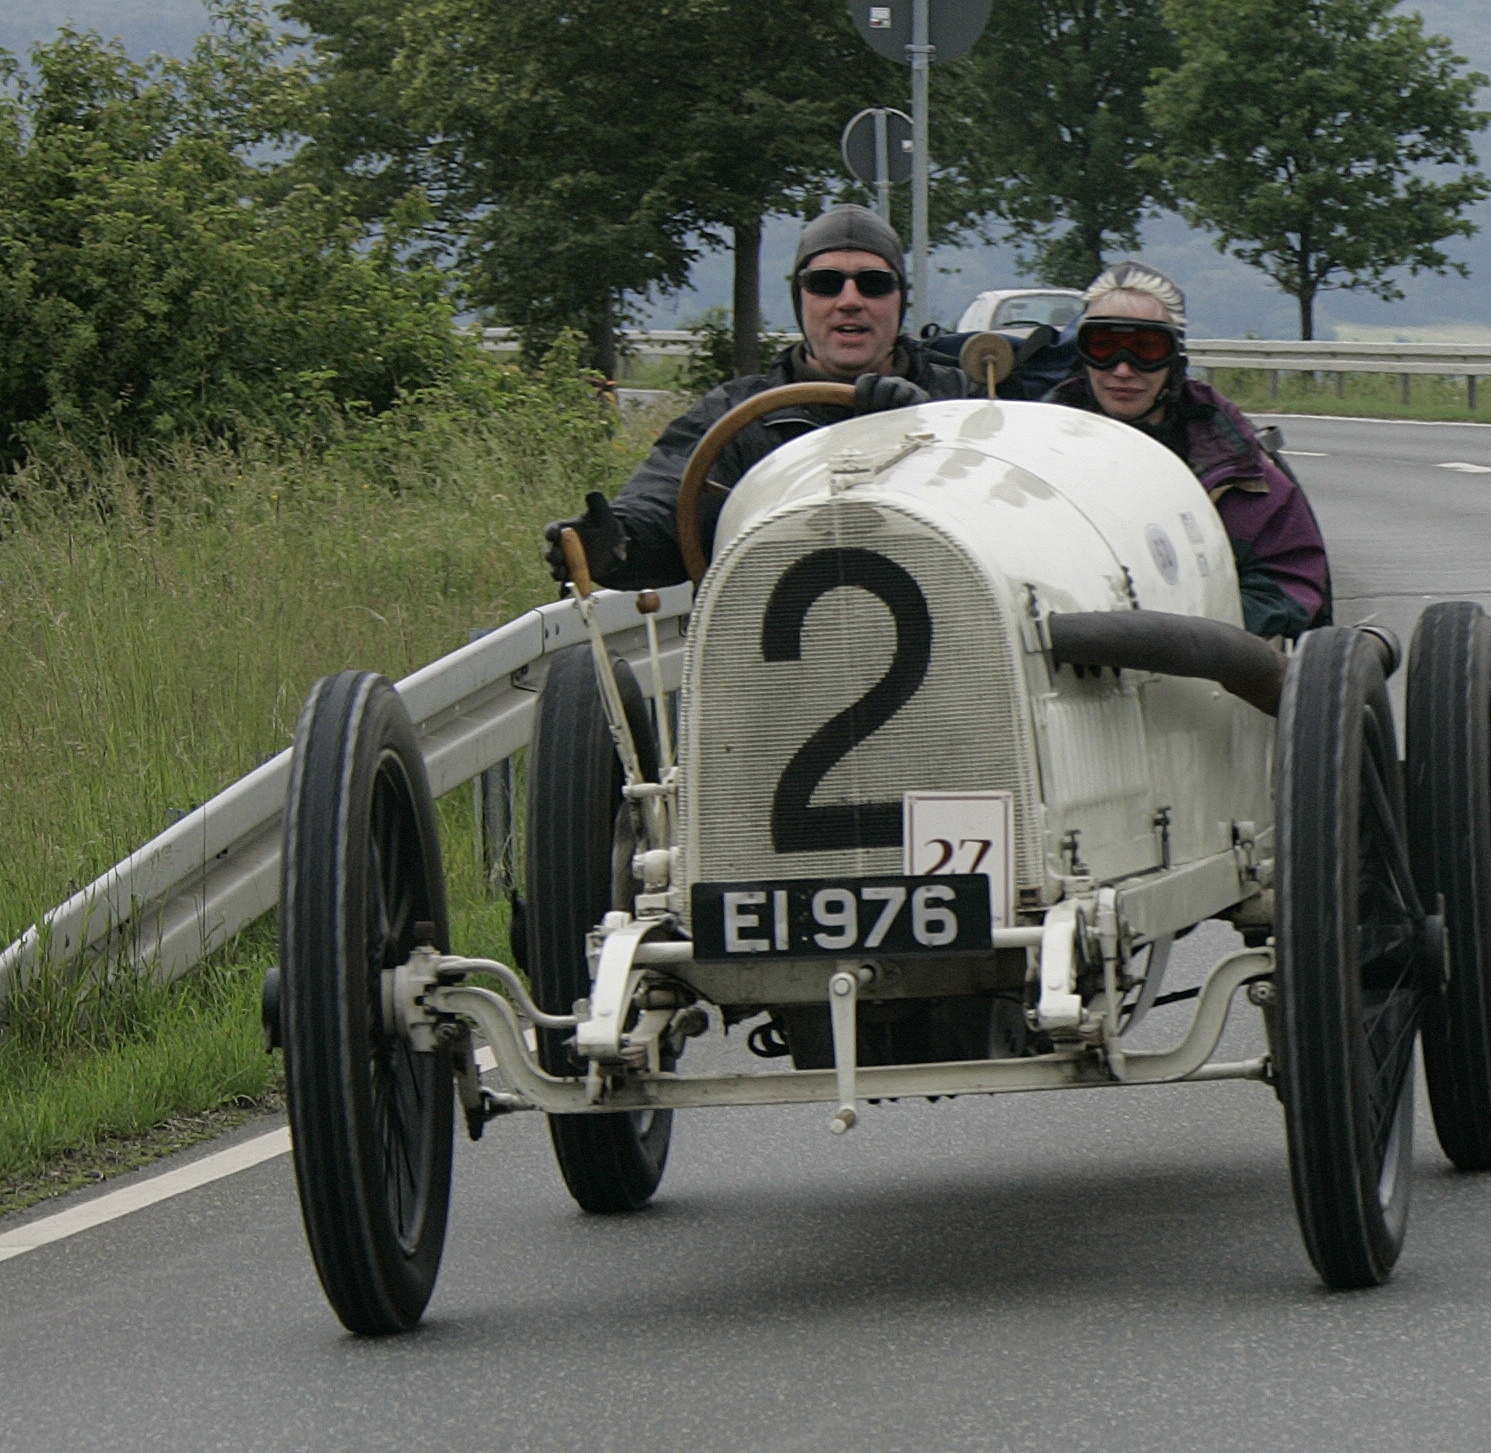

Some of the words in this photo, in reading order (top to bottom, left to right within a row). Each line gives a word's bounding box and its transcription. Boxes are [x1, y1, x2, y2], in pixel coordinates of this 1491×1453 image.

[761, 547, 933, 854] 2
[923, 838, 993, 875] 27
[723, 889, 790, 953] EI
[811, 884, 959, 950] 976
